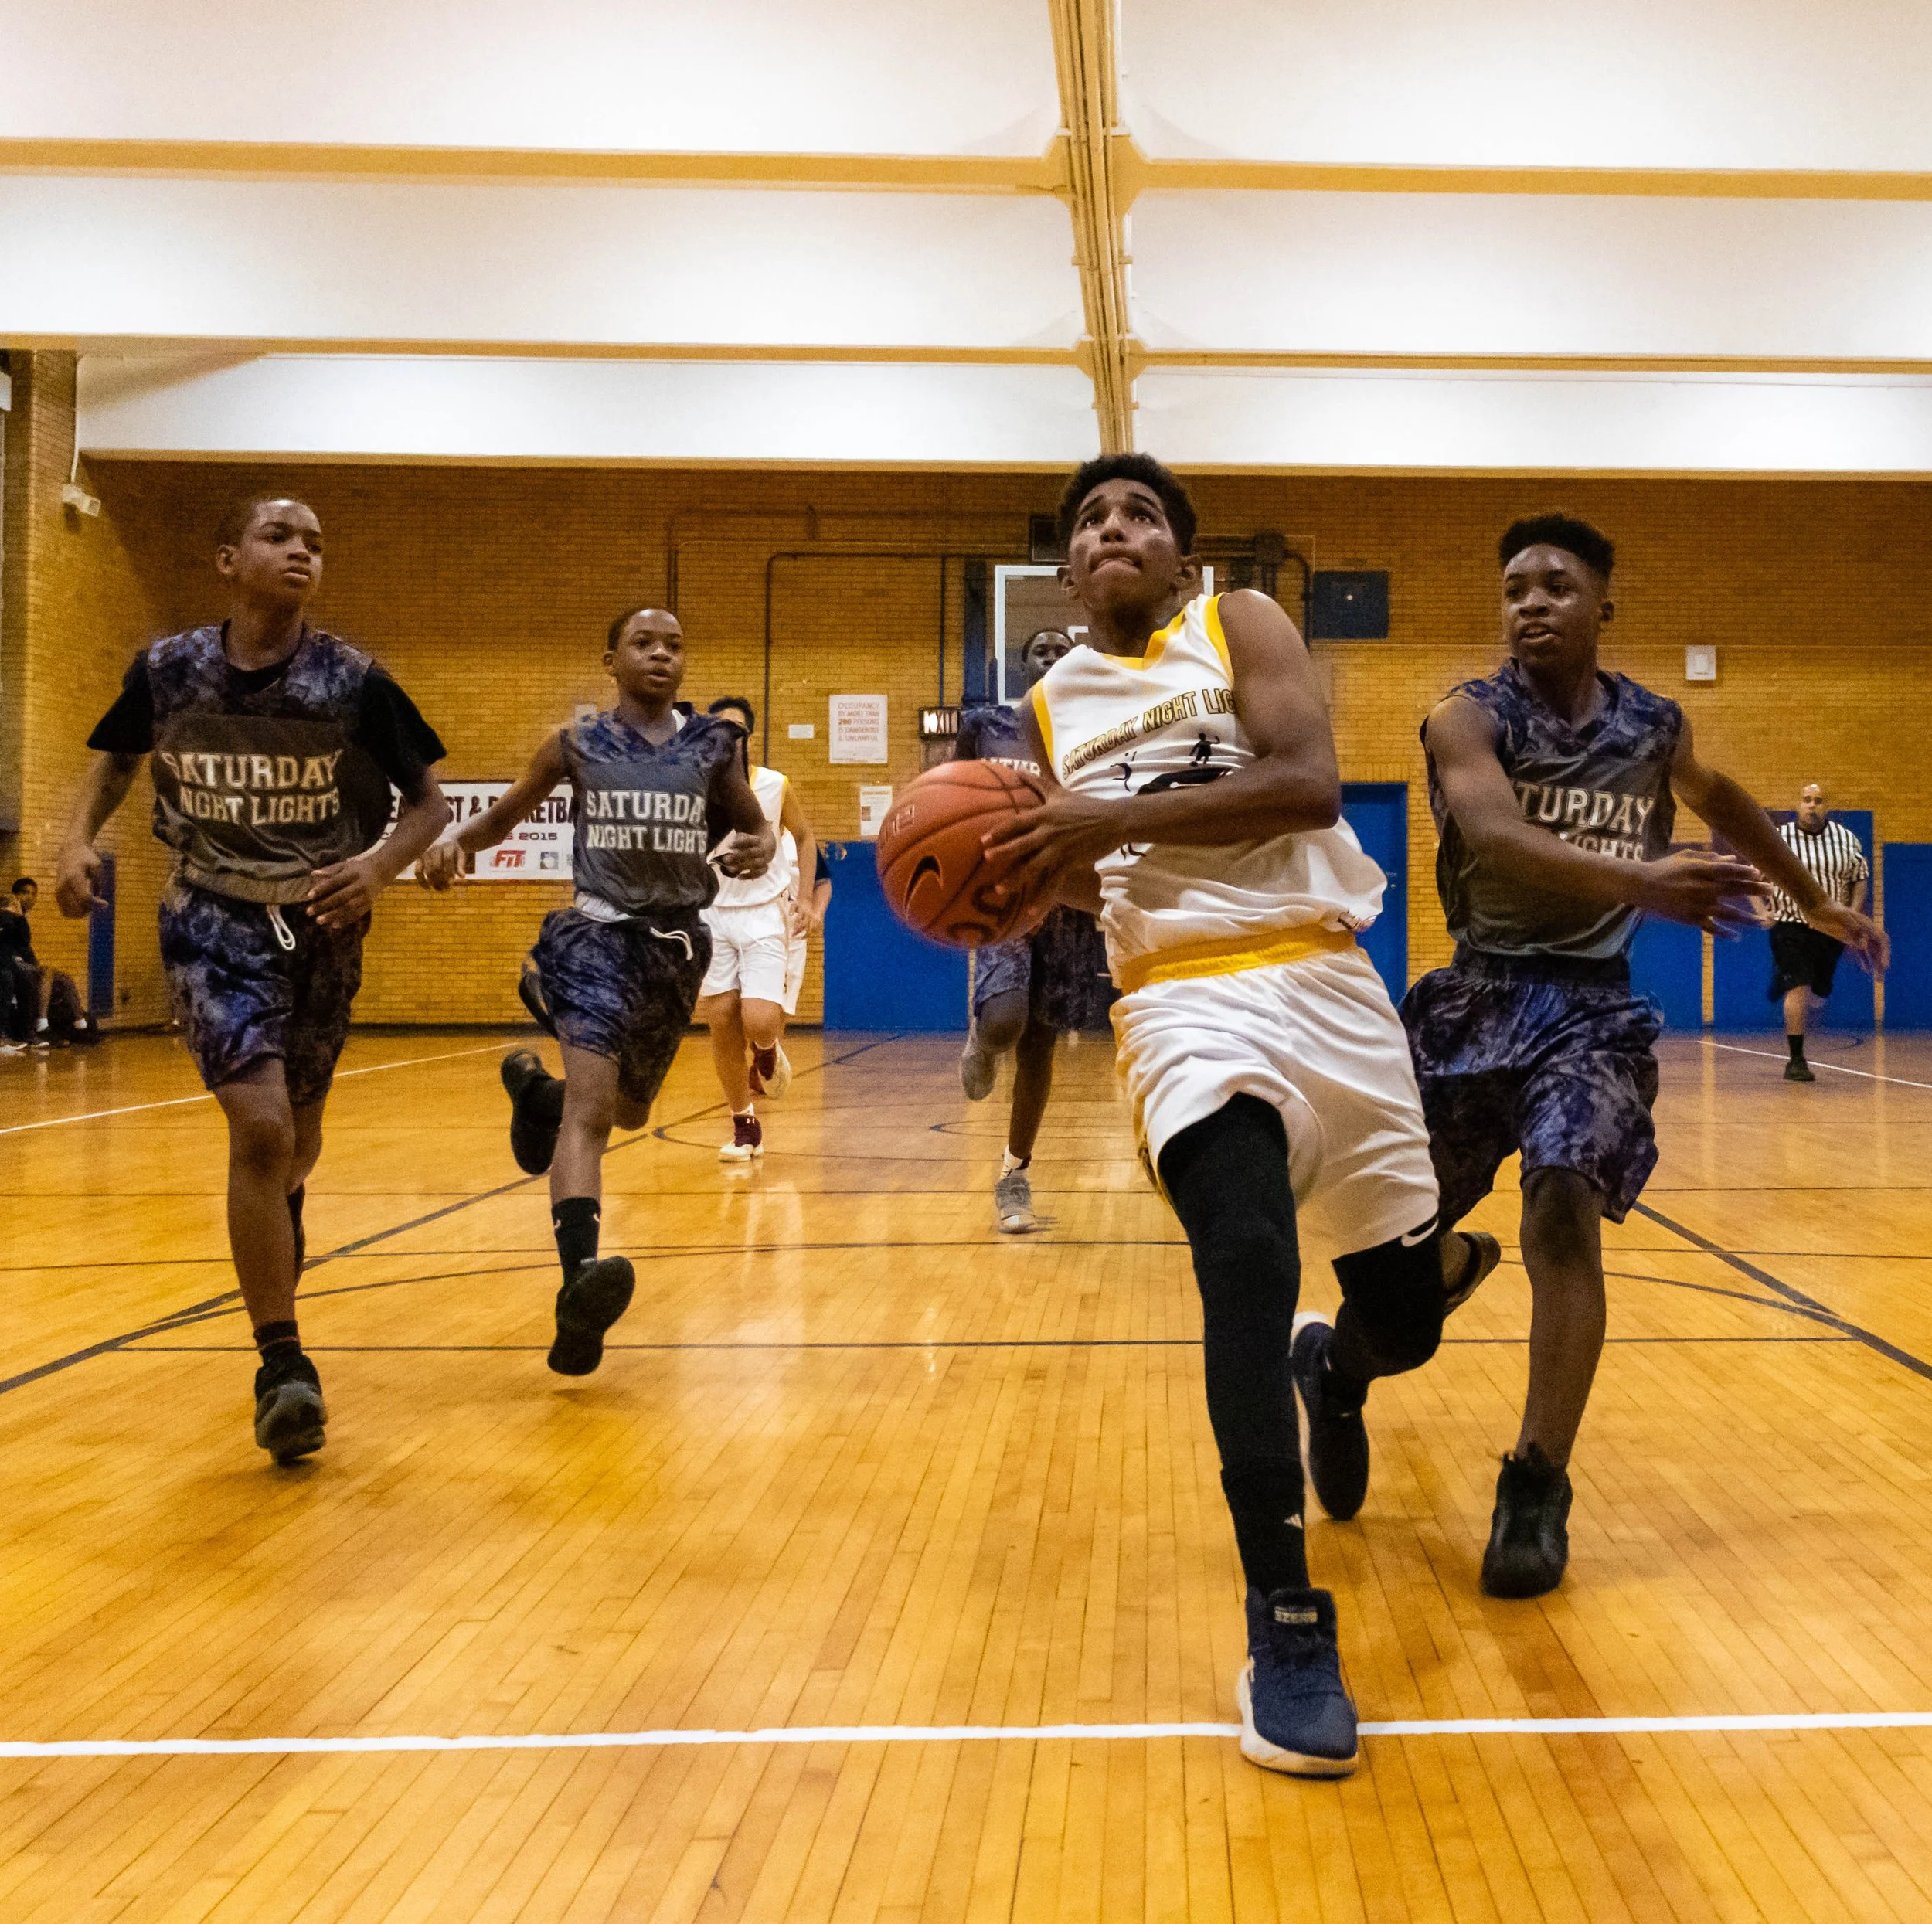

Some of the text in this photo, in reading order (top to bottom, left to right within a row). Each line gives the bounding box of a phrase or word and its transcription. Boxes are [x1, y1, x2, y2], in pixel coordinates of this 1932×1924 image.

[1062, 716, 1138, 780] SATURDAY
[1142, 691, 1198, 733] NIGHT
[1201, 688, 1236, 715] LIG
[161, 749, 344, 789] SATURDAY
[179, 785, 244, 825] NGHT
[250, 787, 340, 825] LIGHTS
[586, 790, 709, 827] SATURDA
[1511, 779, 1655, 835] TURDAY
[519, 831, 558, 841] 2015
[586, 824, 647, 849] NIGHT
